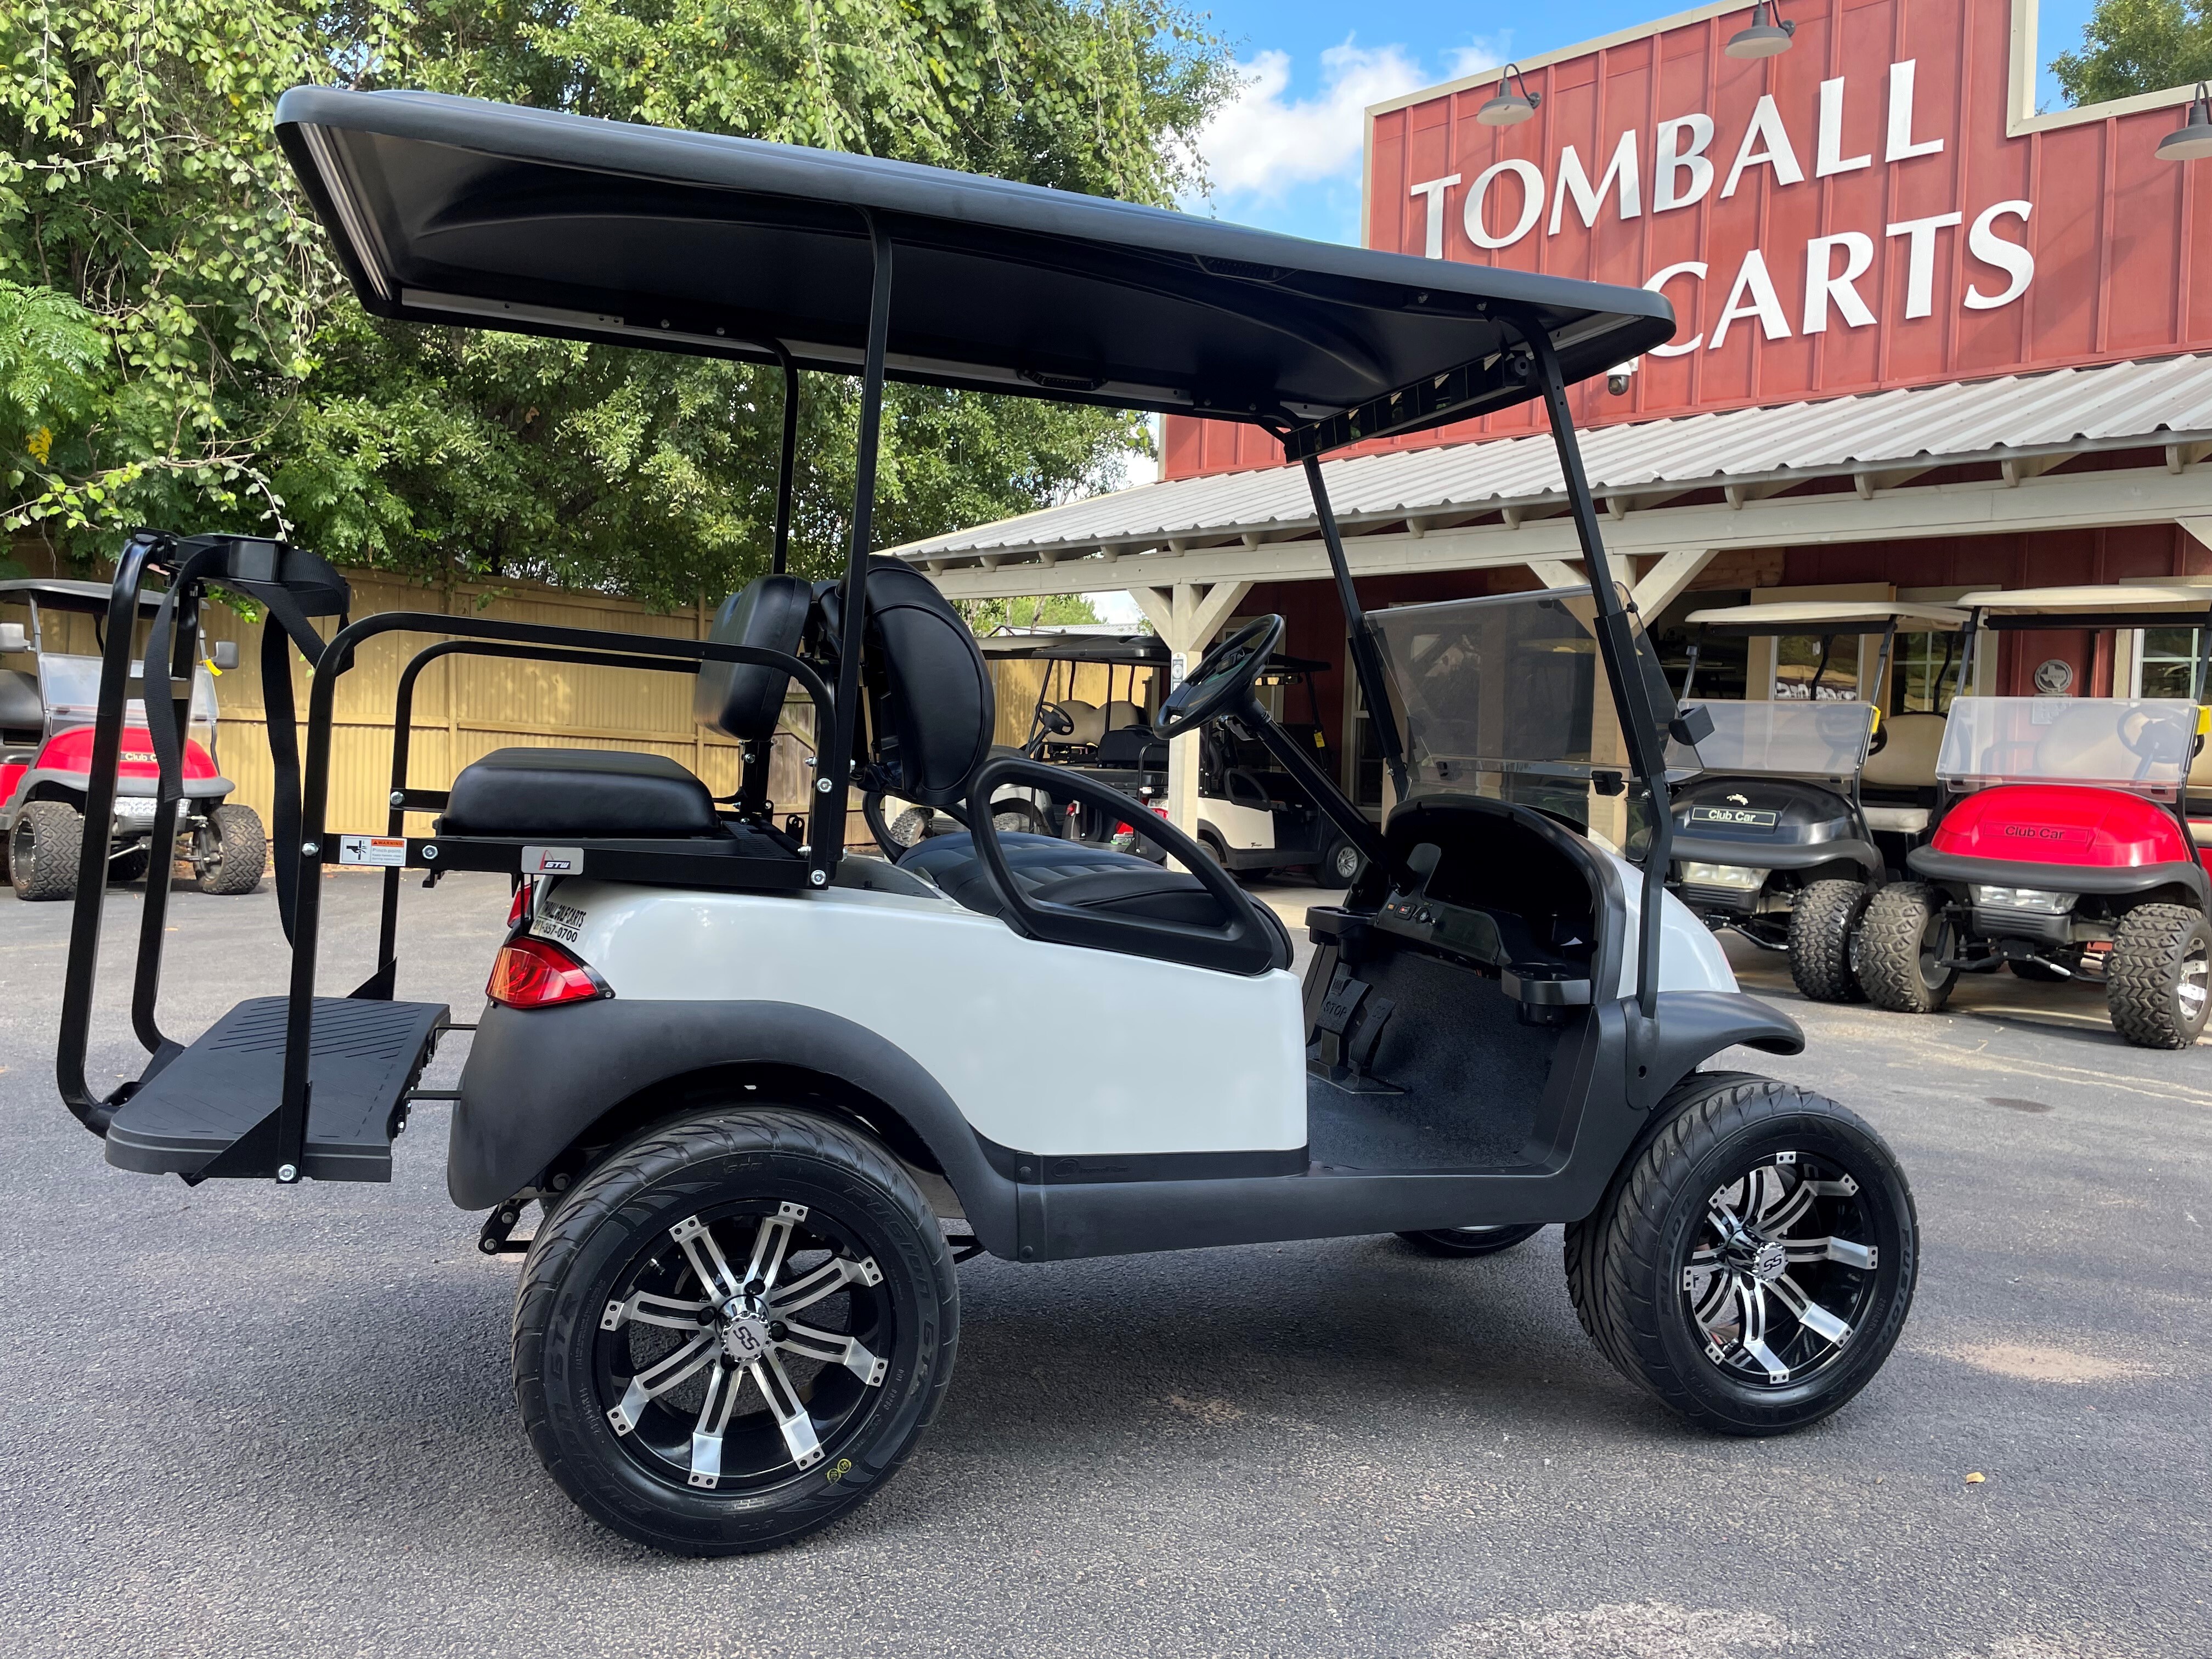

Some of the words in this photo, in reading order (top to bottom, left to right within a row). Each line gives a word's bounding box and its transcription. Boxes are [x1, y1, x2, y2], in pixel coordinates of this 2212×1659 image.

[1410, 59, 1944, 258] TOMBALL
[1642, 199, 2034, 357] CARTS
[125, 753, 148, 761] Club
[1708, 809, 1732, 820] Club
[1735, 811, 1756, 822] Car
[2005, 826, 2035, 837] Club
[2039, 828, 2064, 839] Car
[566, 908, 586, 928] CARTS
